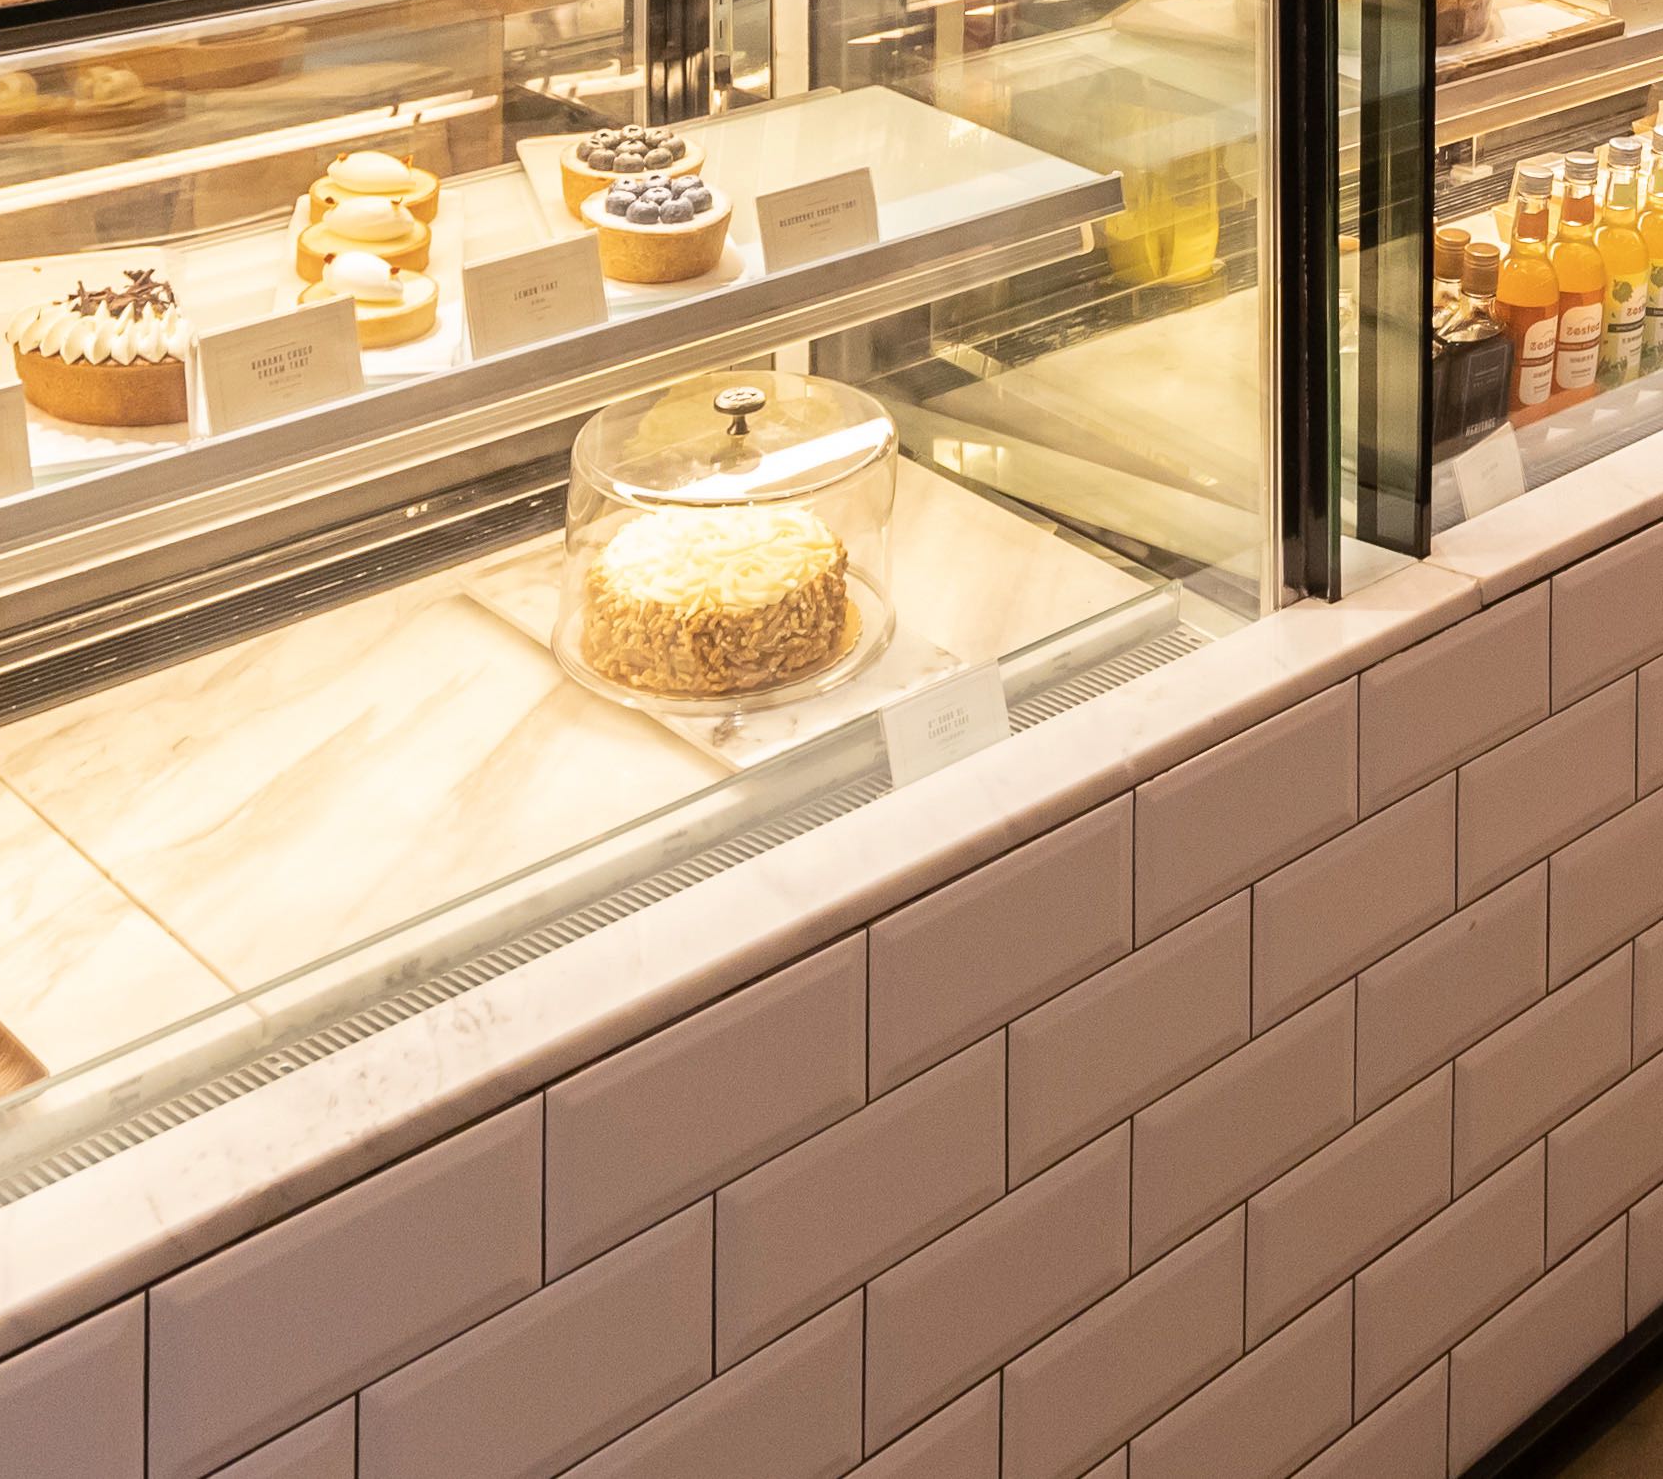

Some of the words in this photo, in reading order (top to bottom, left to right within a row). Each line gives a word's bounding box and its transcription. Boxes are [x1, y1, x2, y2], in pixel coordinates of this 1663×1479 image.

[541, 281, 558, 291] TART
[252, 354, 283, 370] BANANA
[258, 365, 285, 379] CREAM
[290, 357, 309, 369] TART
